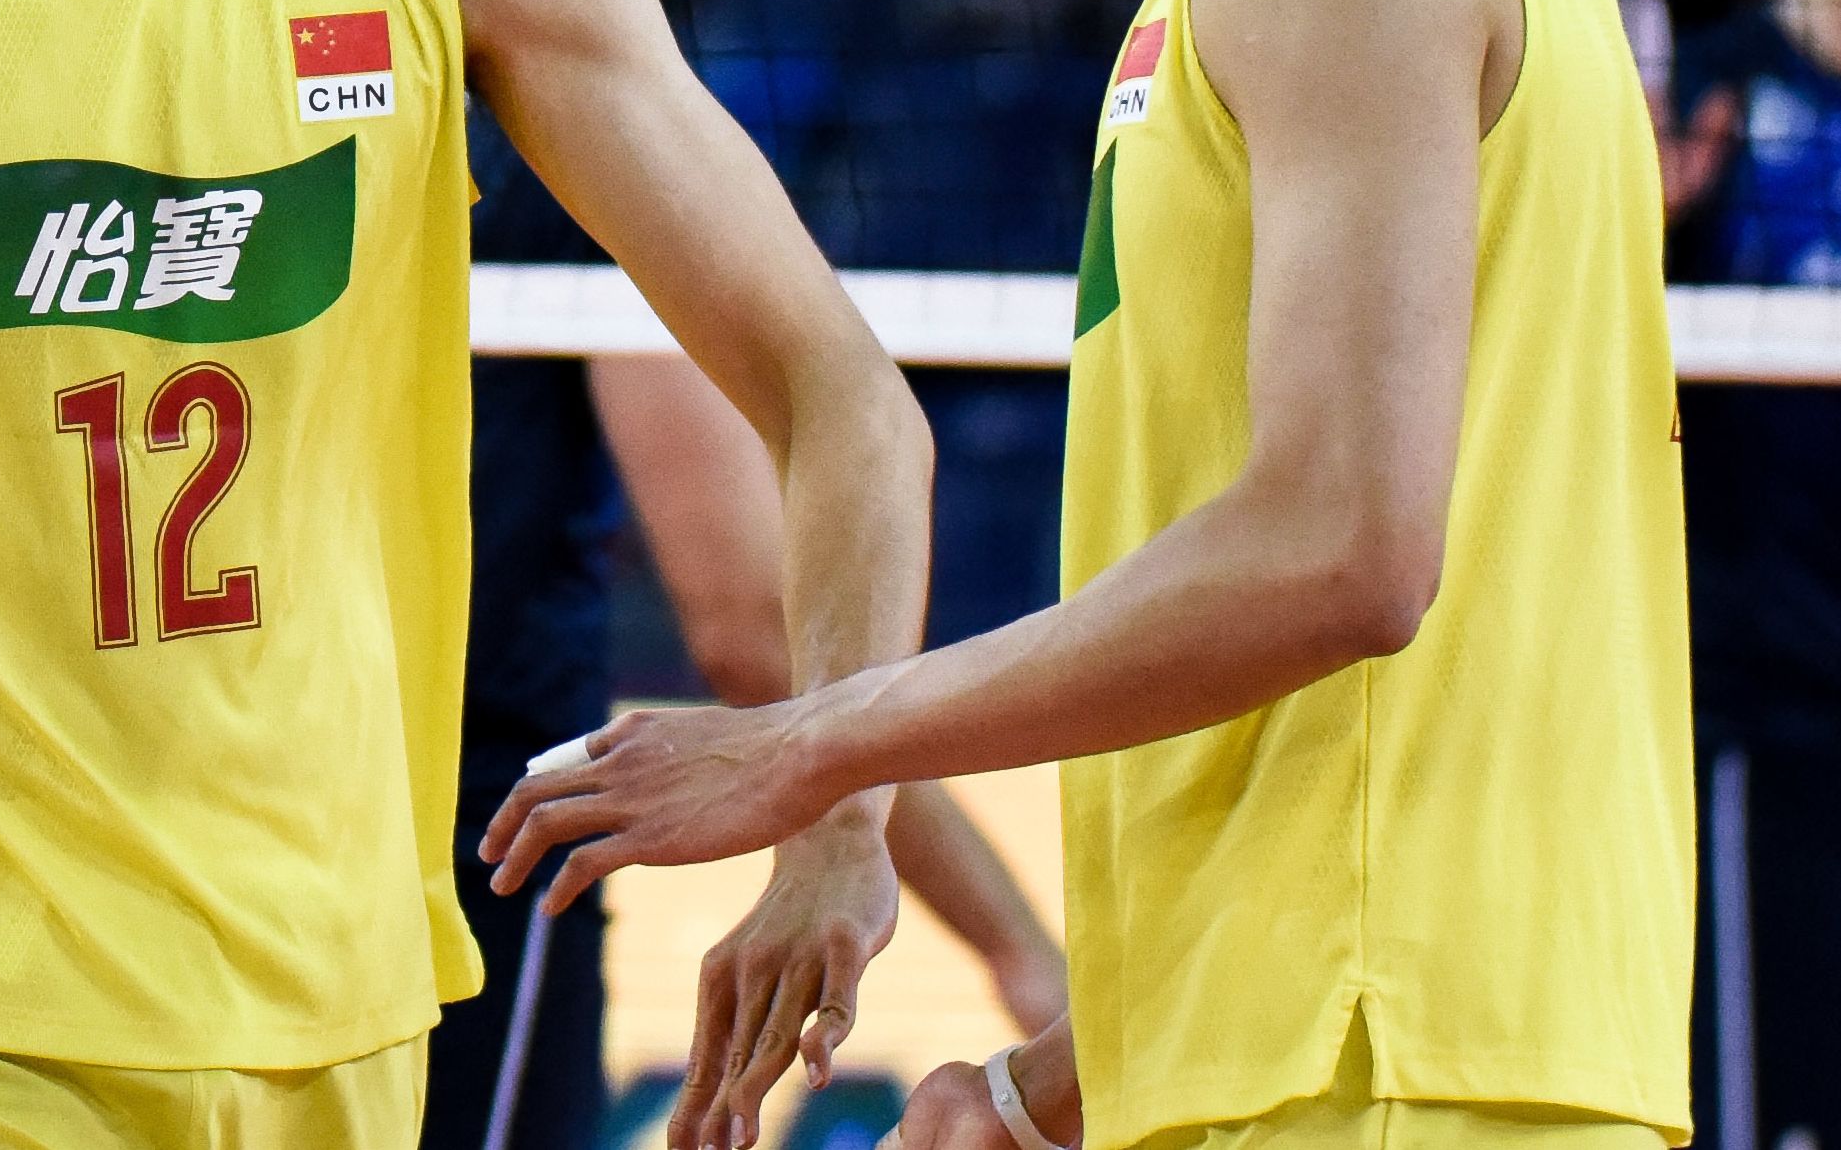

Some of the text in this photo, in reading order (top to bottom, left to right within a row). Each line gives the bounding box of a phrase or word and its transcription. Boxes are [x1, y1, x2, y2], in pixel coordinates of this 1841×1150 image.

[308, 81, 387, 114] CHN
[14, 189, 264, 315] 怡寶
[55, 361, 261, 650] 12
